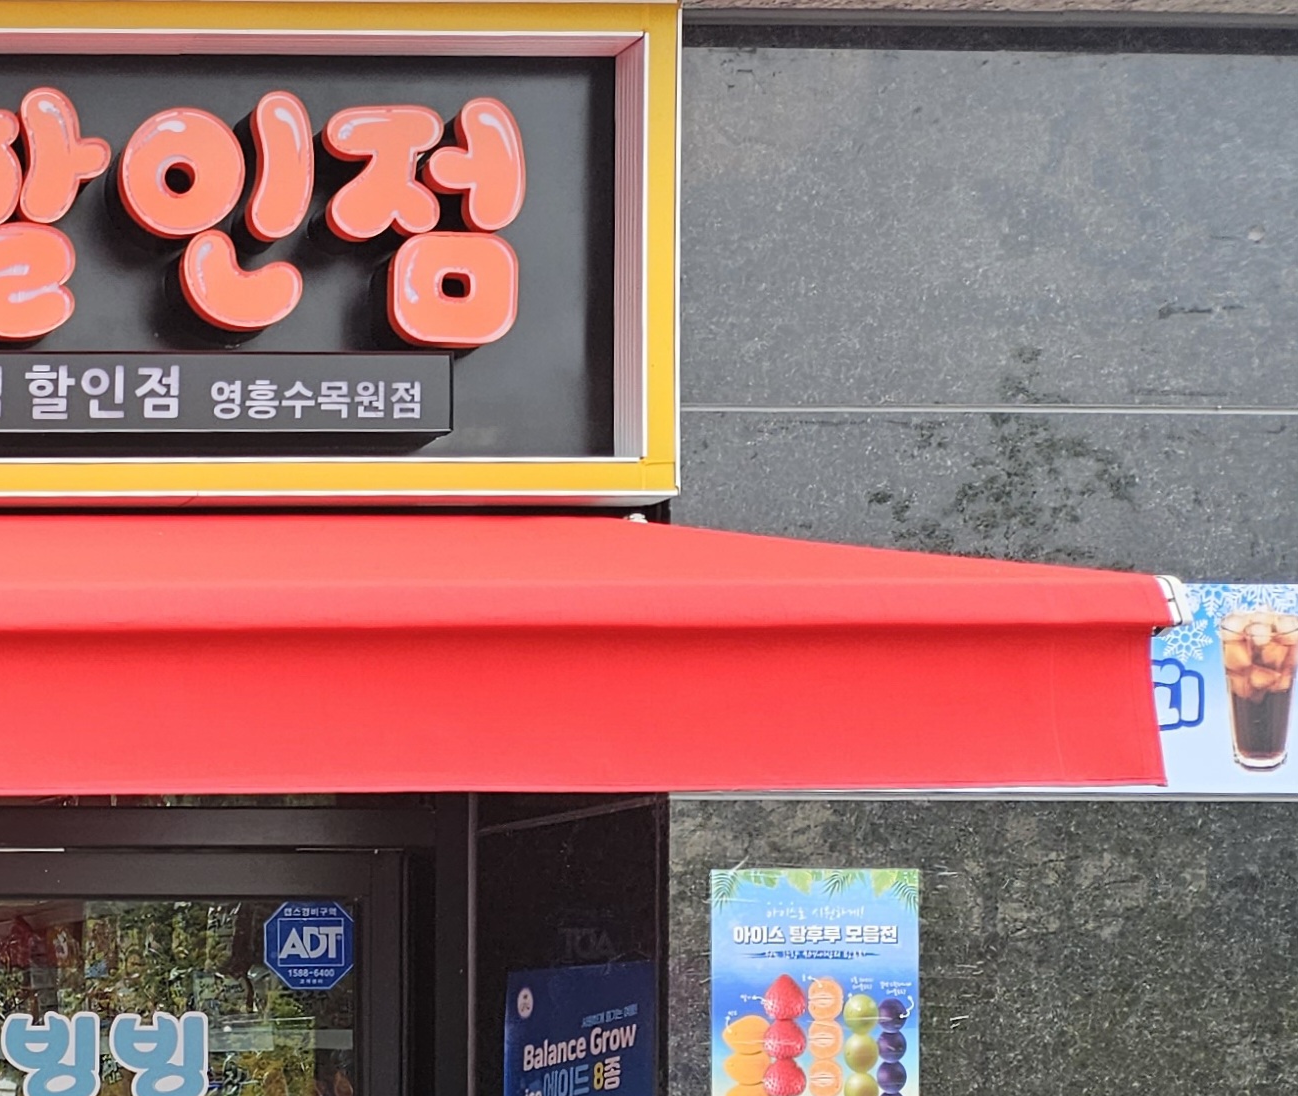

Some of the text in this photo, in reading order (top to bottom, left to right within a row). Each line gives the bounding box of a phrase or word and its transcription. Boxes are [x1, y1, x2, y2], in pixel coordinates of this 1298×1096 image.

[23, 363, 183, 421] 할인점
[209, 379, 424, 420] 영흥수목원점
[279, 926, 344, 959] ADT
[733, 925, 898, 945] 아이스 탕후루 모음전
[288, 968, 335, 978] 1588-6400
[523, 1023, 637, 1072] Balance Grow
[593, 1056, 621, 1091] 8종
